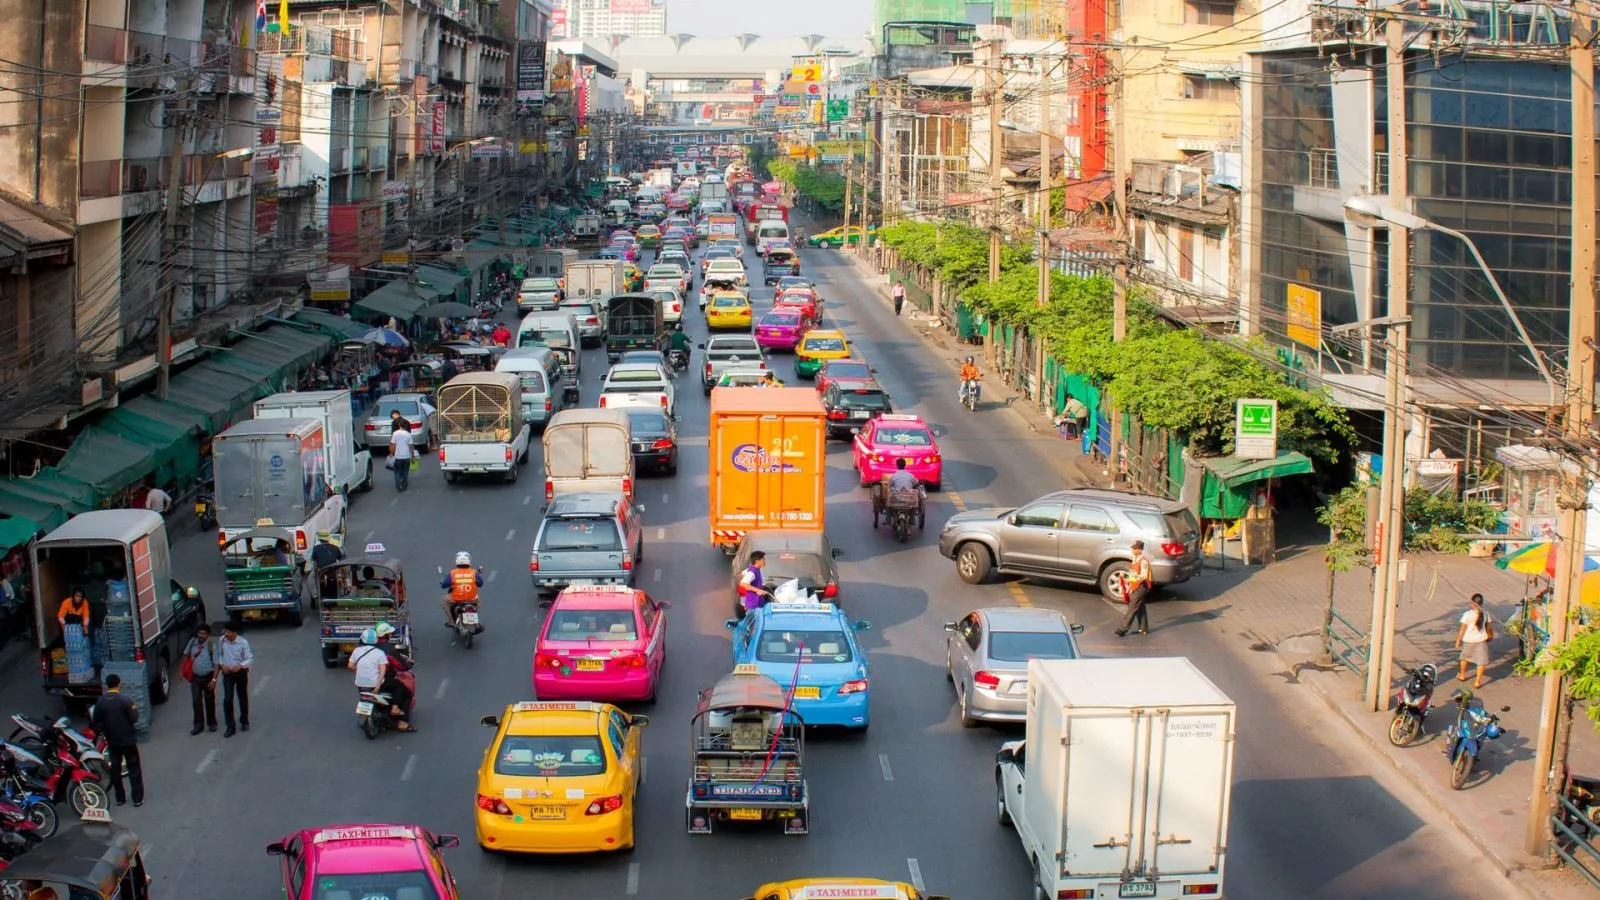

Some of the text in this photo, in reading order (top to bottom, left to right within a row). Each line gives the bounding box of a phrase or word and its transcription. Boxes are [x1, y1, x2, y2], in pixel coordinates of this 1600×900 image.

[804, 69, 816, 82] 2
[87, 809, 105, 818] TAXI
[337, 829, 391, 838] TAXI-METER
[816, 888, 878, 897] TAXI-METER
